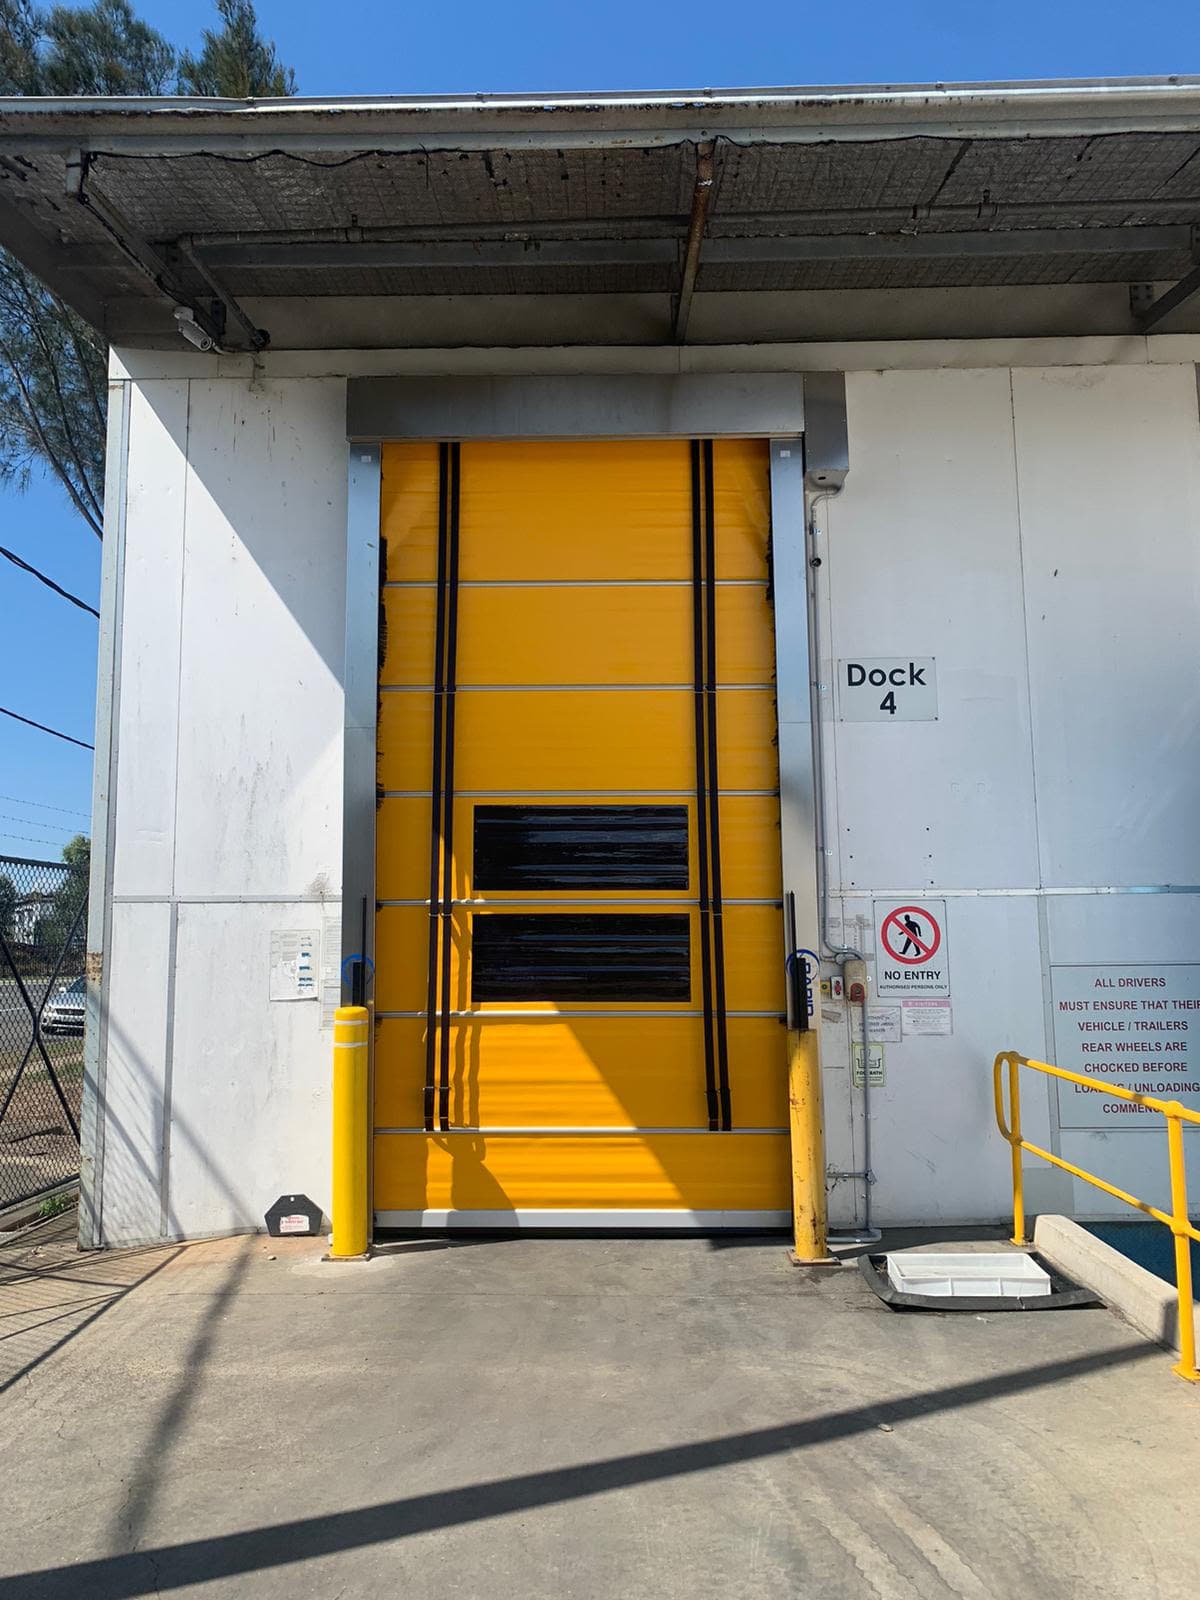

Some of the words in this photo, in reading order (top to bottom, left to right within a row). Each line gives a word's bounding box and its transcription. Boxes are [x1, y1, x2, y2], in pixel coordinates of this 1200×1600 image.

[847, 662, 927, 686] Dock
[880, 691, 897, 714] 4
[884, 970, 901, 980] NO
[904, 970, 941, 980] ENTRY
[1094, 978, 1116, 988] ALL
[1118, 977, 1167, 988] DRIVERS
[1059, 1000, 1090, 1011] MUST
[1093, 1000, 1138, 1010] ENSURE
[1140, 1000, 1169, 1010] THAT
[1078, 1021, 1125, 1031] VEHICLE
[1134, 1020, 1189, 1031] TRAILERS
[1082, 1042, 1113, 1052] REAR
[1115, 1042, 1162, 1052] WHEELS
[1164, 1041, 1188, 1052] ARE
[1084, 1062, 1139, 1072] CHOCKED
[1142, 1062, 1188, 1072] BEFORE
[1134, 1082, 1200, 1092] UNLOADING
